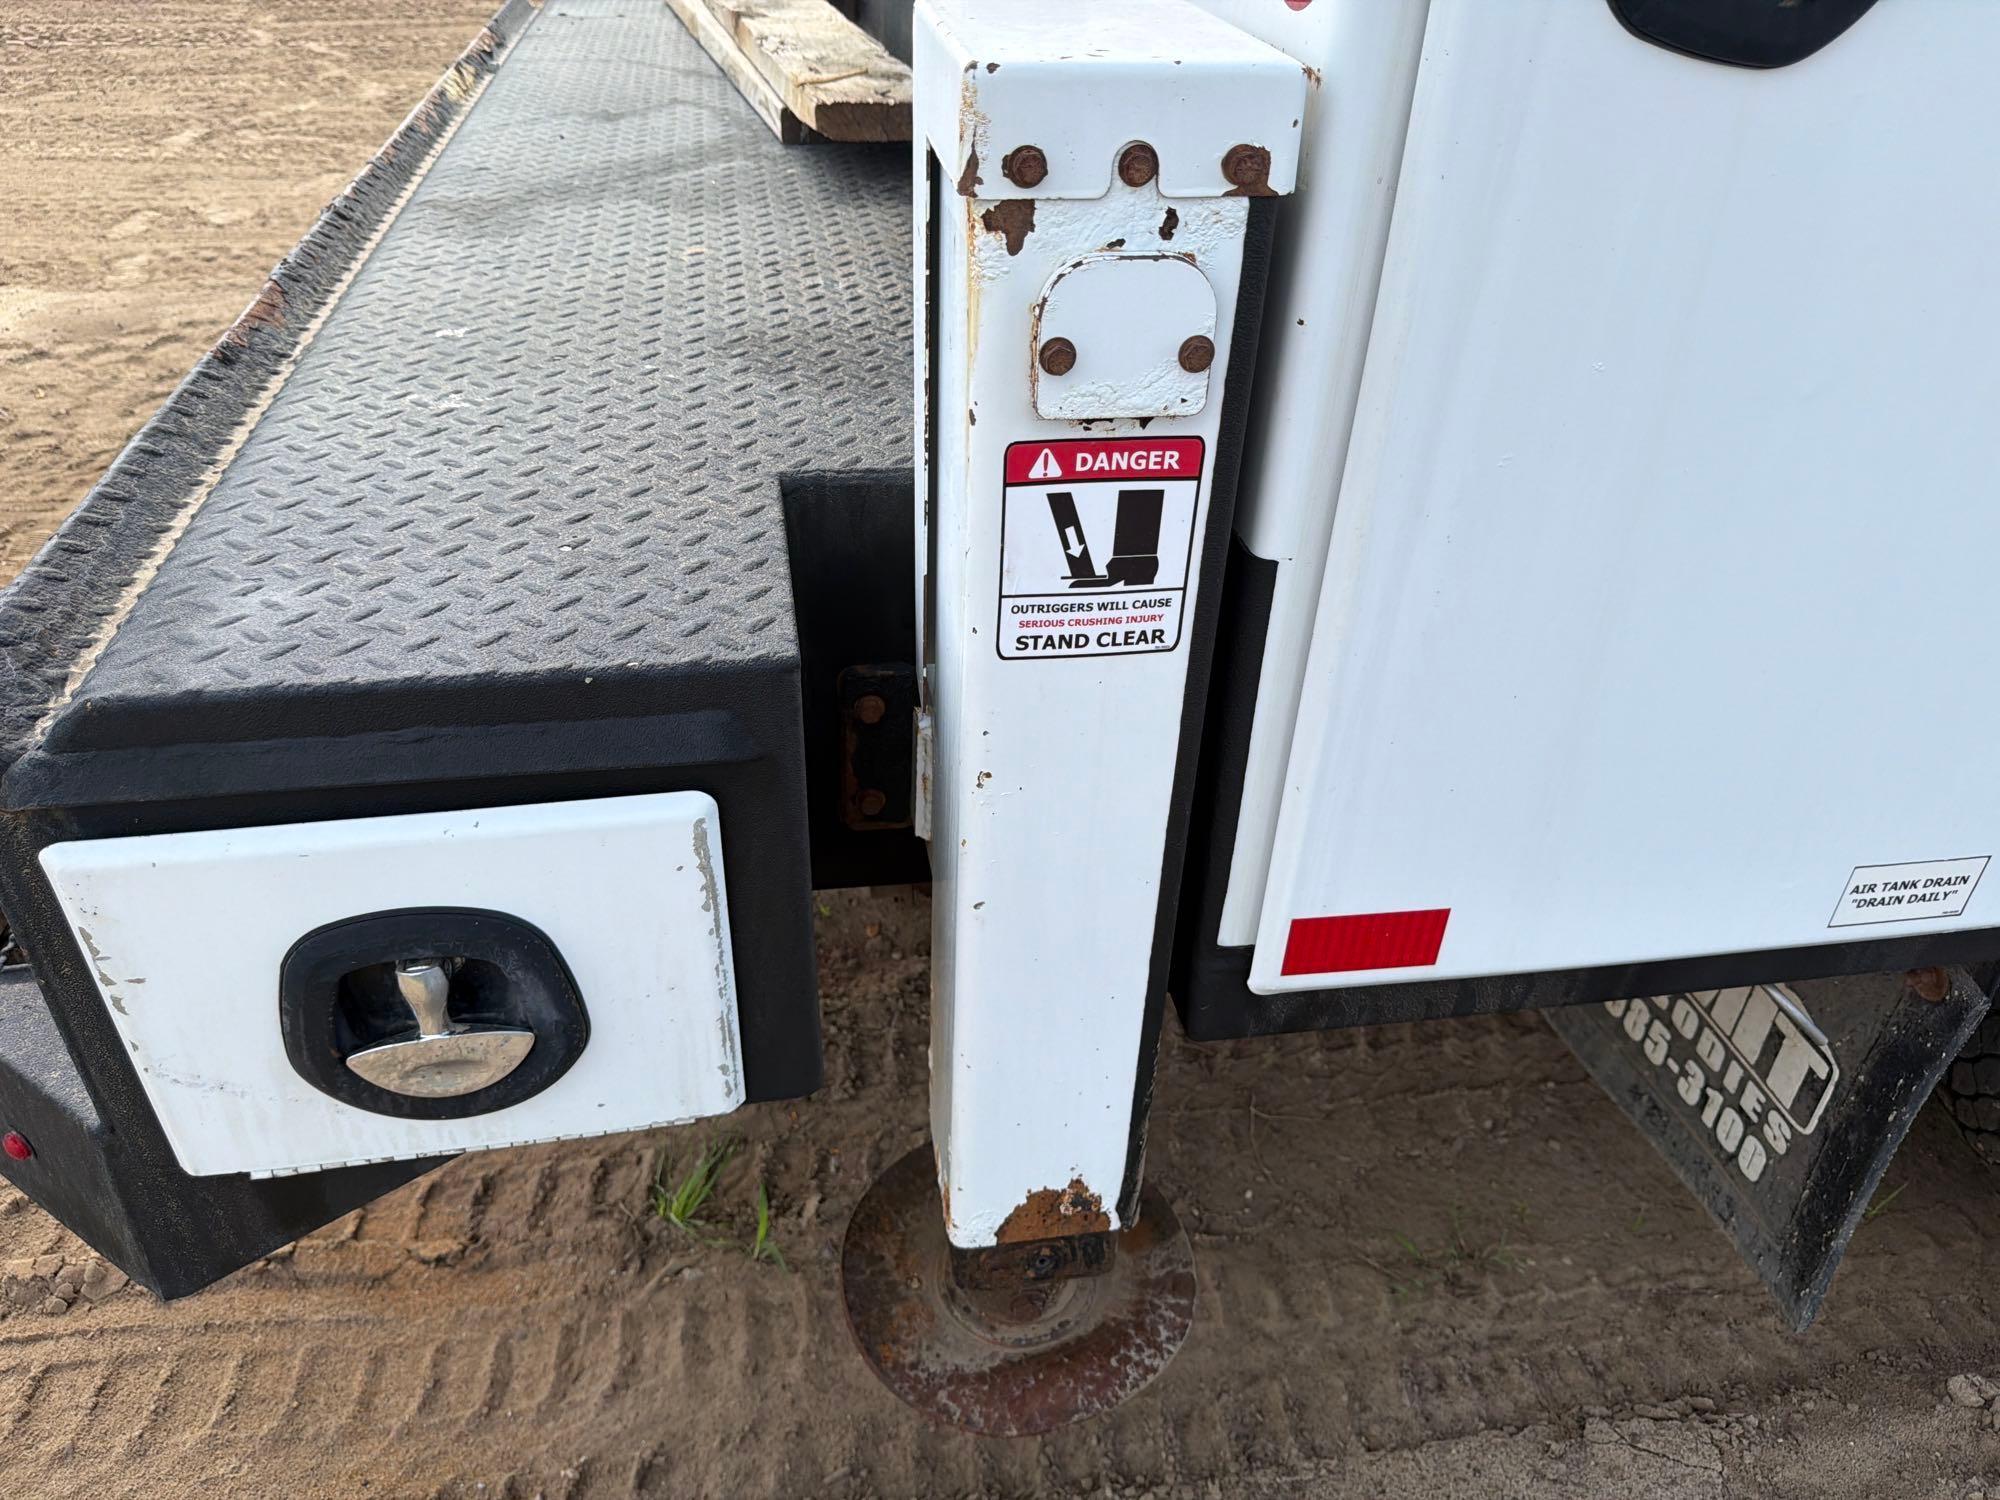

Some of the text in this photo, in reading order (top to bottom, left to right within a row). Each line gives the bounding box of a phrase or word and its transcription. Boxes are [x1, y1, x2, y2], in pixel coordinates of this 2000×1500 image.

[1075, 450, 1180, 472] DANGER
[1010, 598, 1173, 614] OUTRIGGERS WILL CAUSE
[1018, 613, 1165, 628] SERIOUS CRUSHING INJURY
[1015, 629, 1166, 651] STAND CLEAR
[1848, 875, 1971, 895] AIR TANK DRAIN
[1851, 890, 1959, 909] "DRAIN DAILY"
